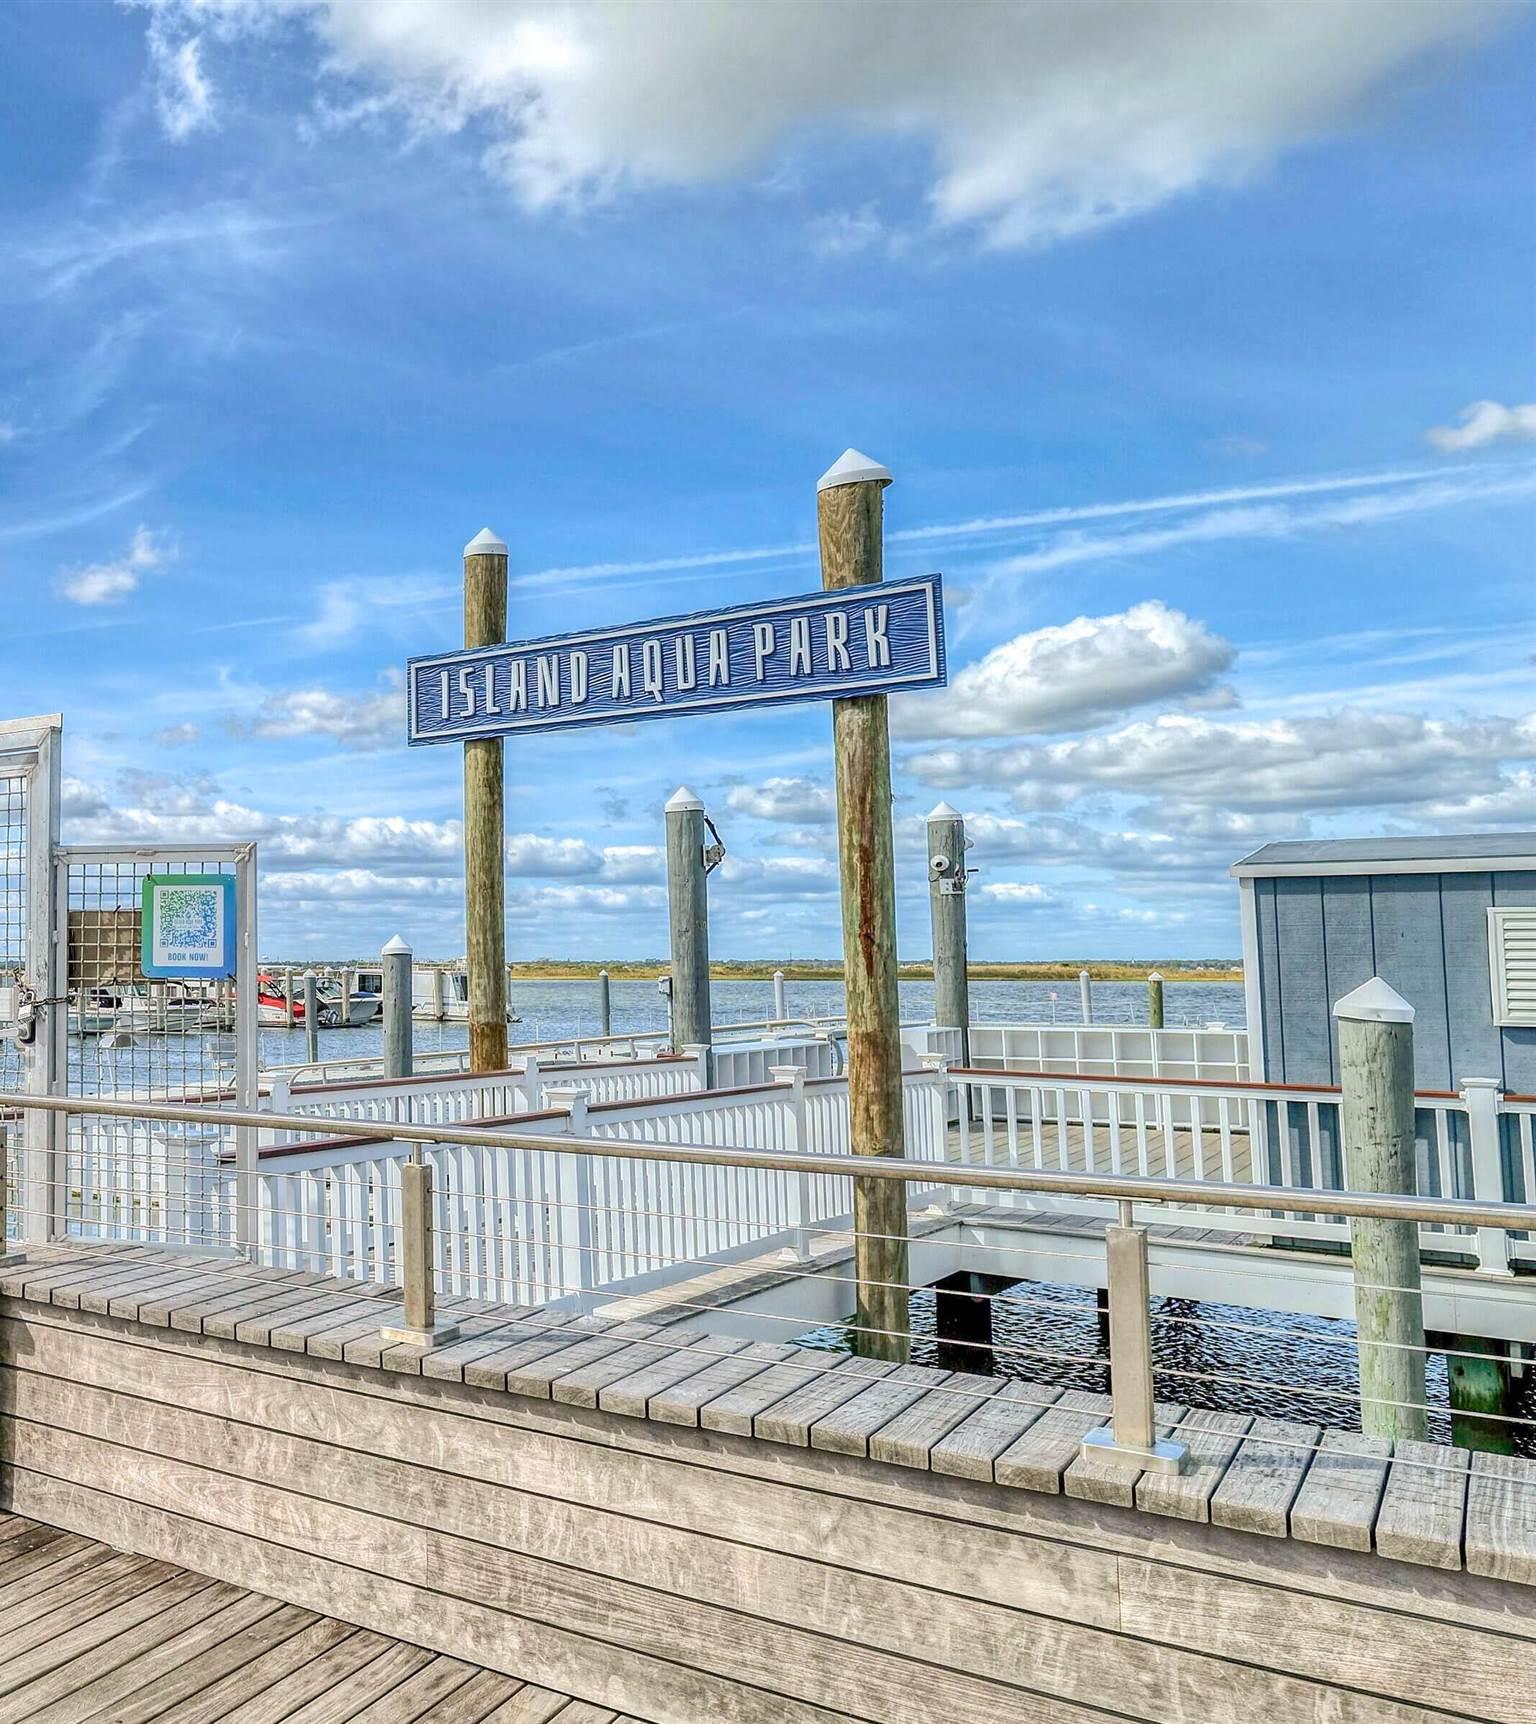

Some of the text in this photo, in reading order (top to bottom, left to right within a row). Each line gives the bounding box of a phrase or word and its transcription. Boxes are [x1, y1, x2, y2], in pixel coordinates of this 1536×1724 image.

[439, 604, 892, 720] ISLAND AQUA PARK
[167, 952, 209, 961] BOOK NOW!
